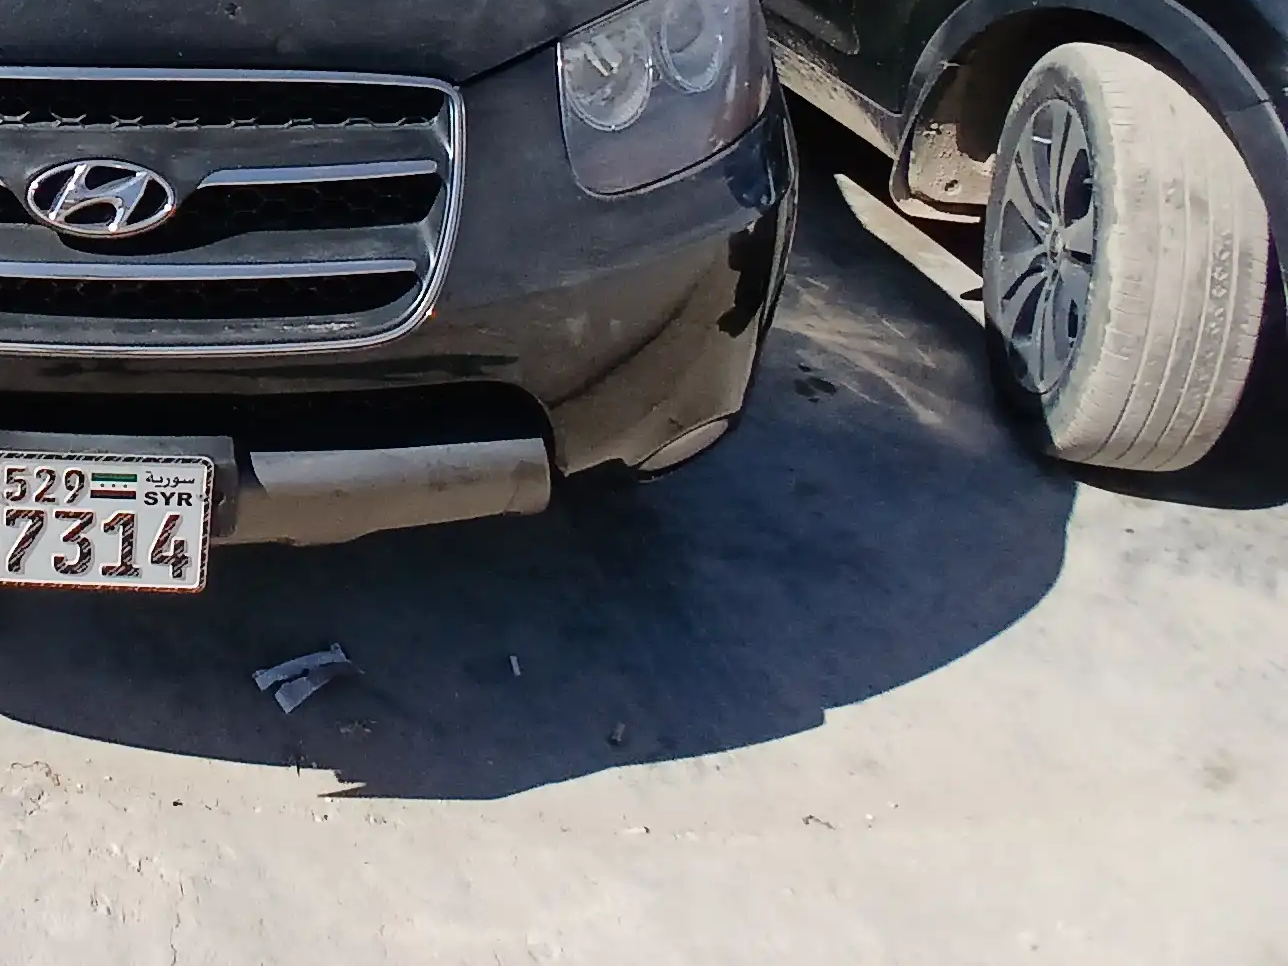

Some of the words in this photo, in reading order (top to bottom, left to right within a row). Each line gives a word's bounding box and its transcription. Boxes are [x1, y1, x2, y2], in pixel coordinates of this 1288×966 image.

[5, 467, 86, 504] 529
[144, 470, 196, 489] سورية
[143, 491, 194, 507] SYR
[5, 509, 192, 579] 7314
